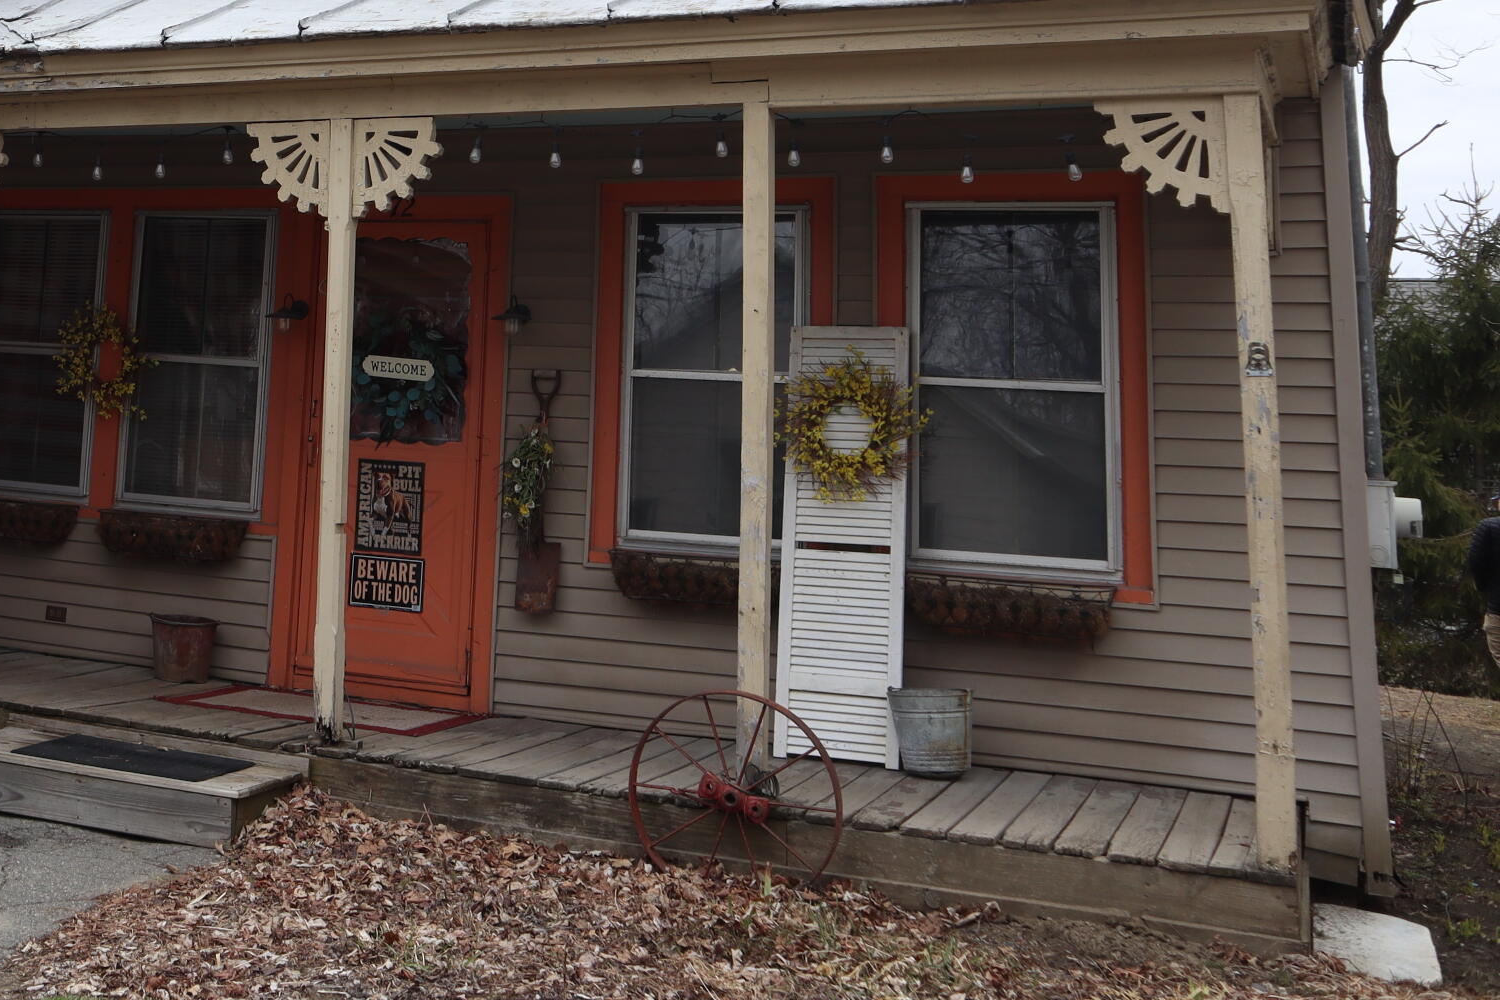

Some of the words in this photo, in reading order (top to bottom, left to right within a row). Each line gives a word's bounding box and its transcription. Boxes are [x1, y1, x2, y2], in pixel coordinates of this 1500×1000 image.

[371, 360, 427, 376] WELCOME
[398, 465, 421, 479] PIT
[393, 478, 421, 493] BULL
[357, 462, 373, 547] AMERICAN
[372, 534, 419, 552] TERRIER
[357, 558, 417, 584] BEWARE
[354, 580, 369, 600] OF
[371, 581, 392, 603] THE
[394, 584, 418, 605] DOG
